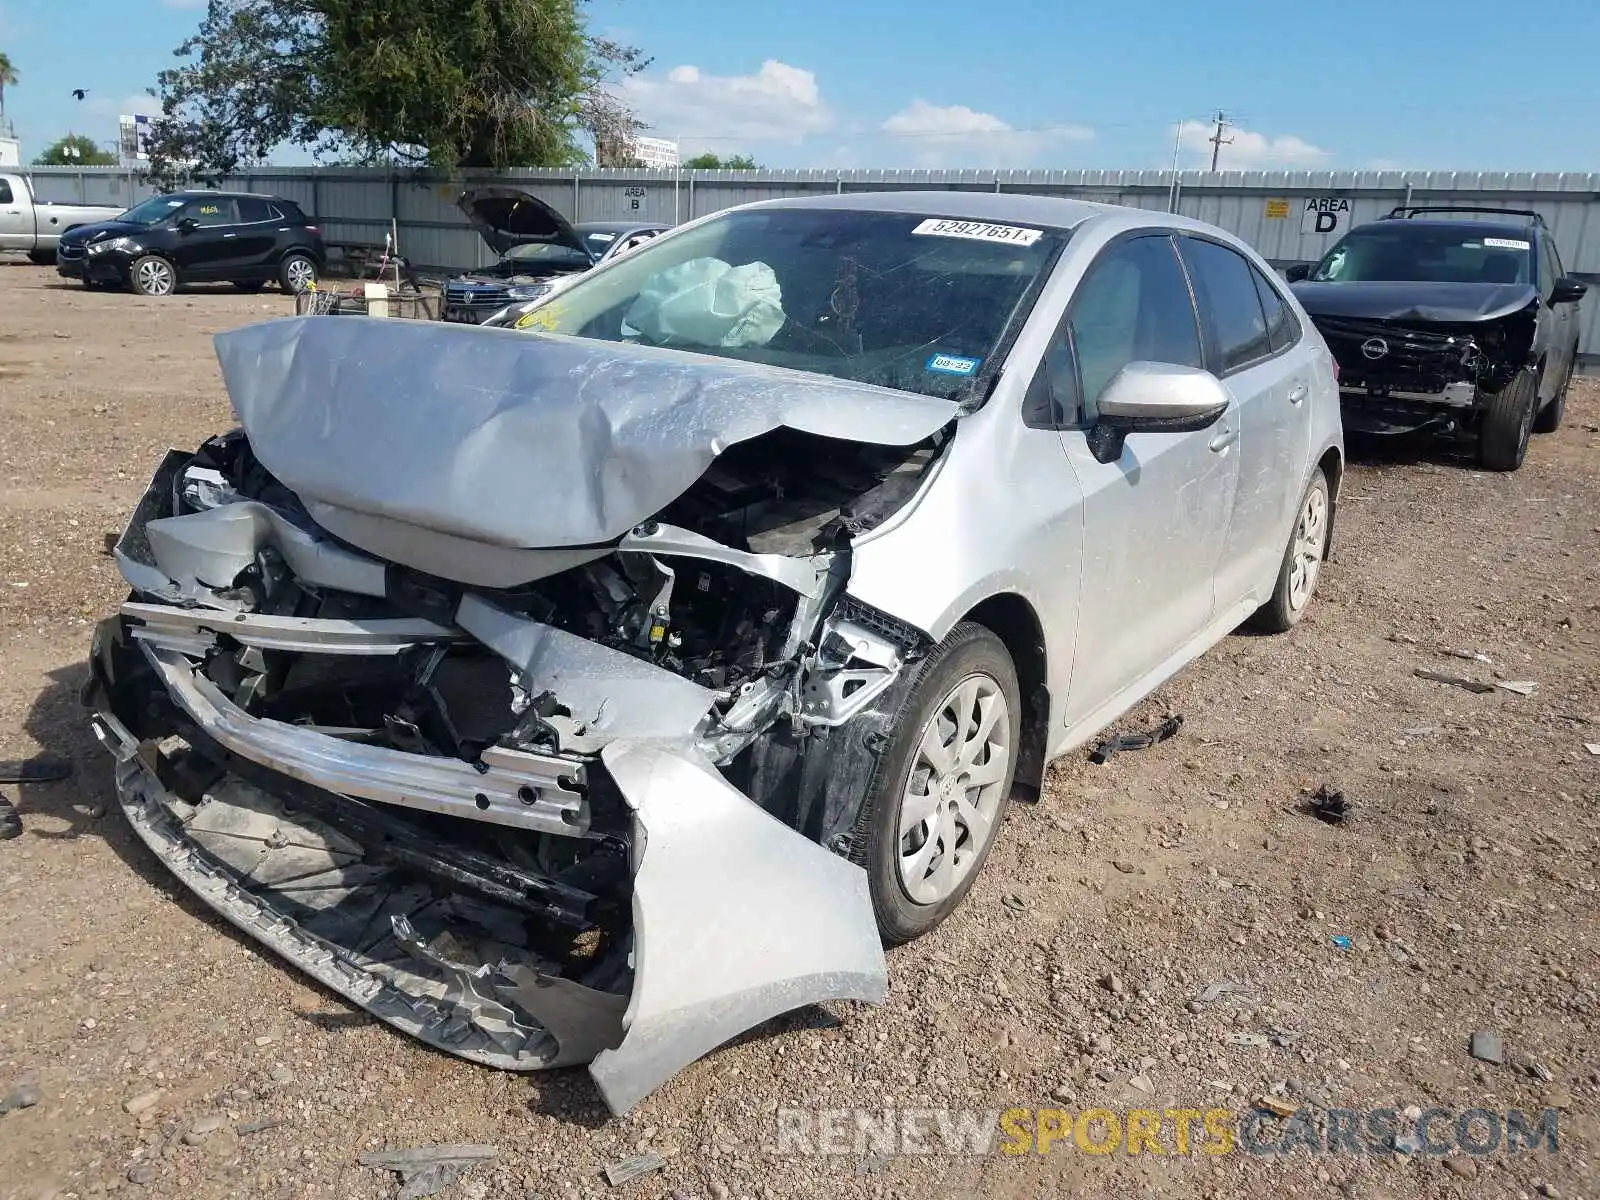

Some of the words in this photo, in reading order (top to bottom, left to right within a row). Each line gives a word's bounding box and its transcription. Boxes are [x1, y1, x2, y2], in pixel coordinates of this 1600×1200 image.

[624, 187, 646, 197] AREA
[631, 199, 640, 210] B
[1306, 198, 1349, 212] AREA
[1314, 211, 1338, 233] D
